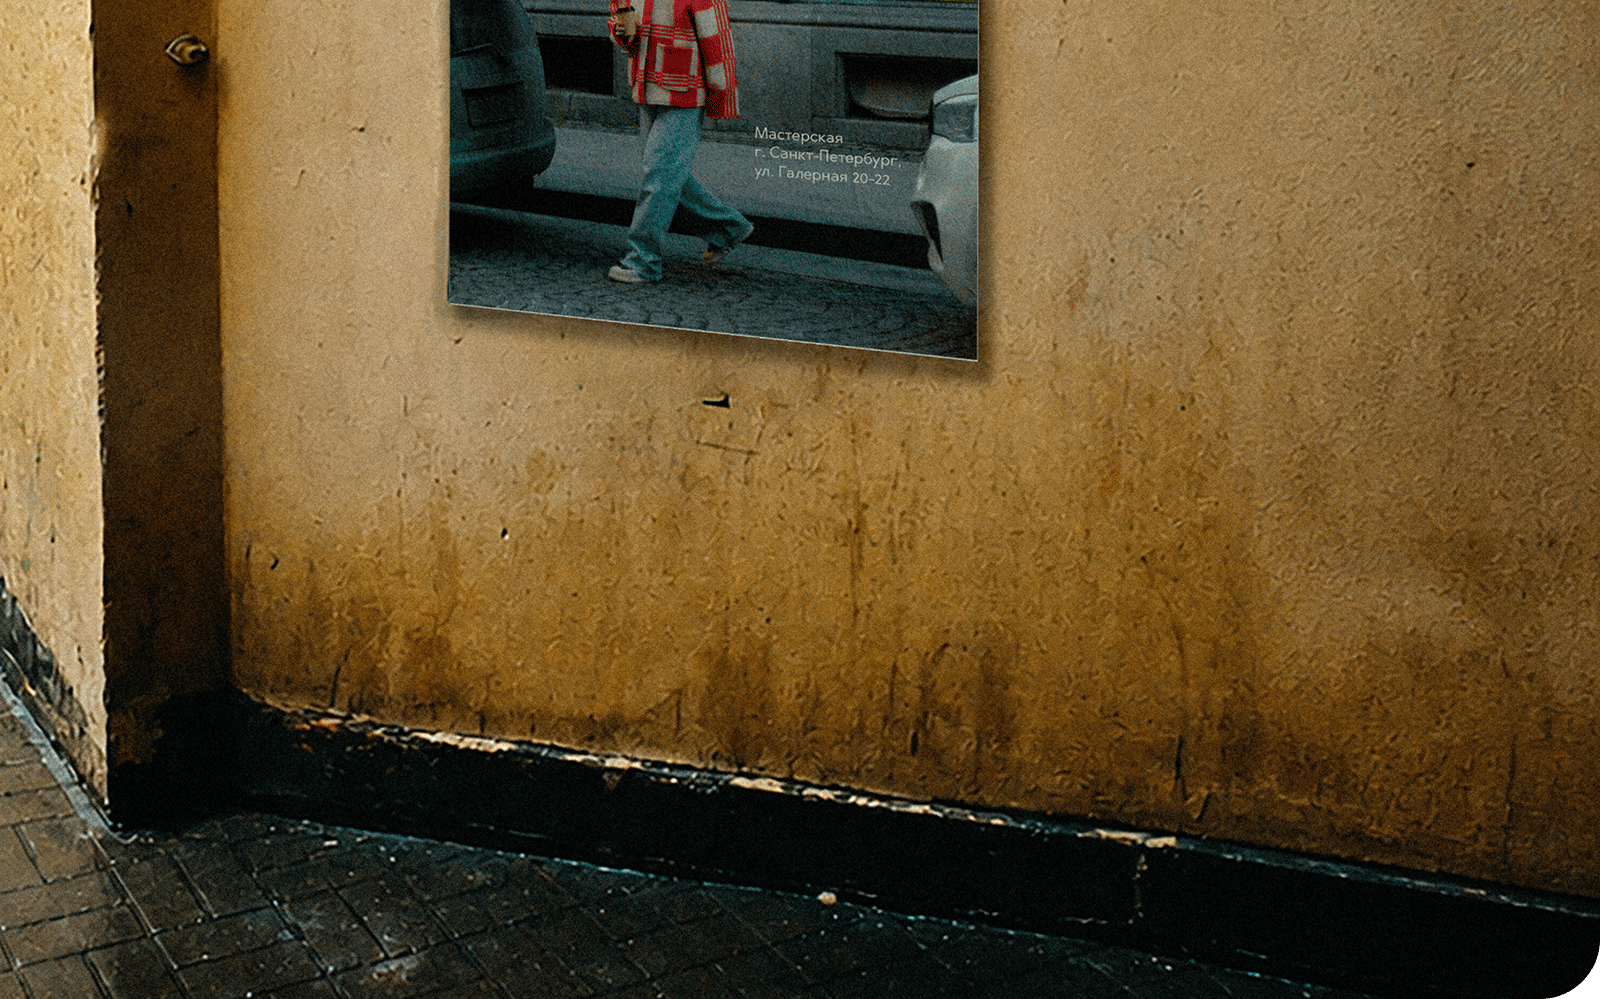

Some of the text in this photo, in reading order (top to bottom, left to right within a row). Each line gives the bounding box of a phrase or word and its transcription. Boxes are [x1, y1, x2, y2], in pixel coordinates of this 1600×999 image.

[754, 126, 843, 145] Мастерская
[754, 146, 902, 169] г. Санкт-Петербург,
[754, 165, 890, 186] ул. Галерная 20-22
